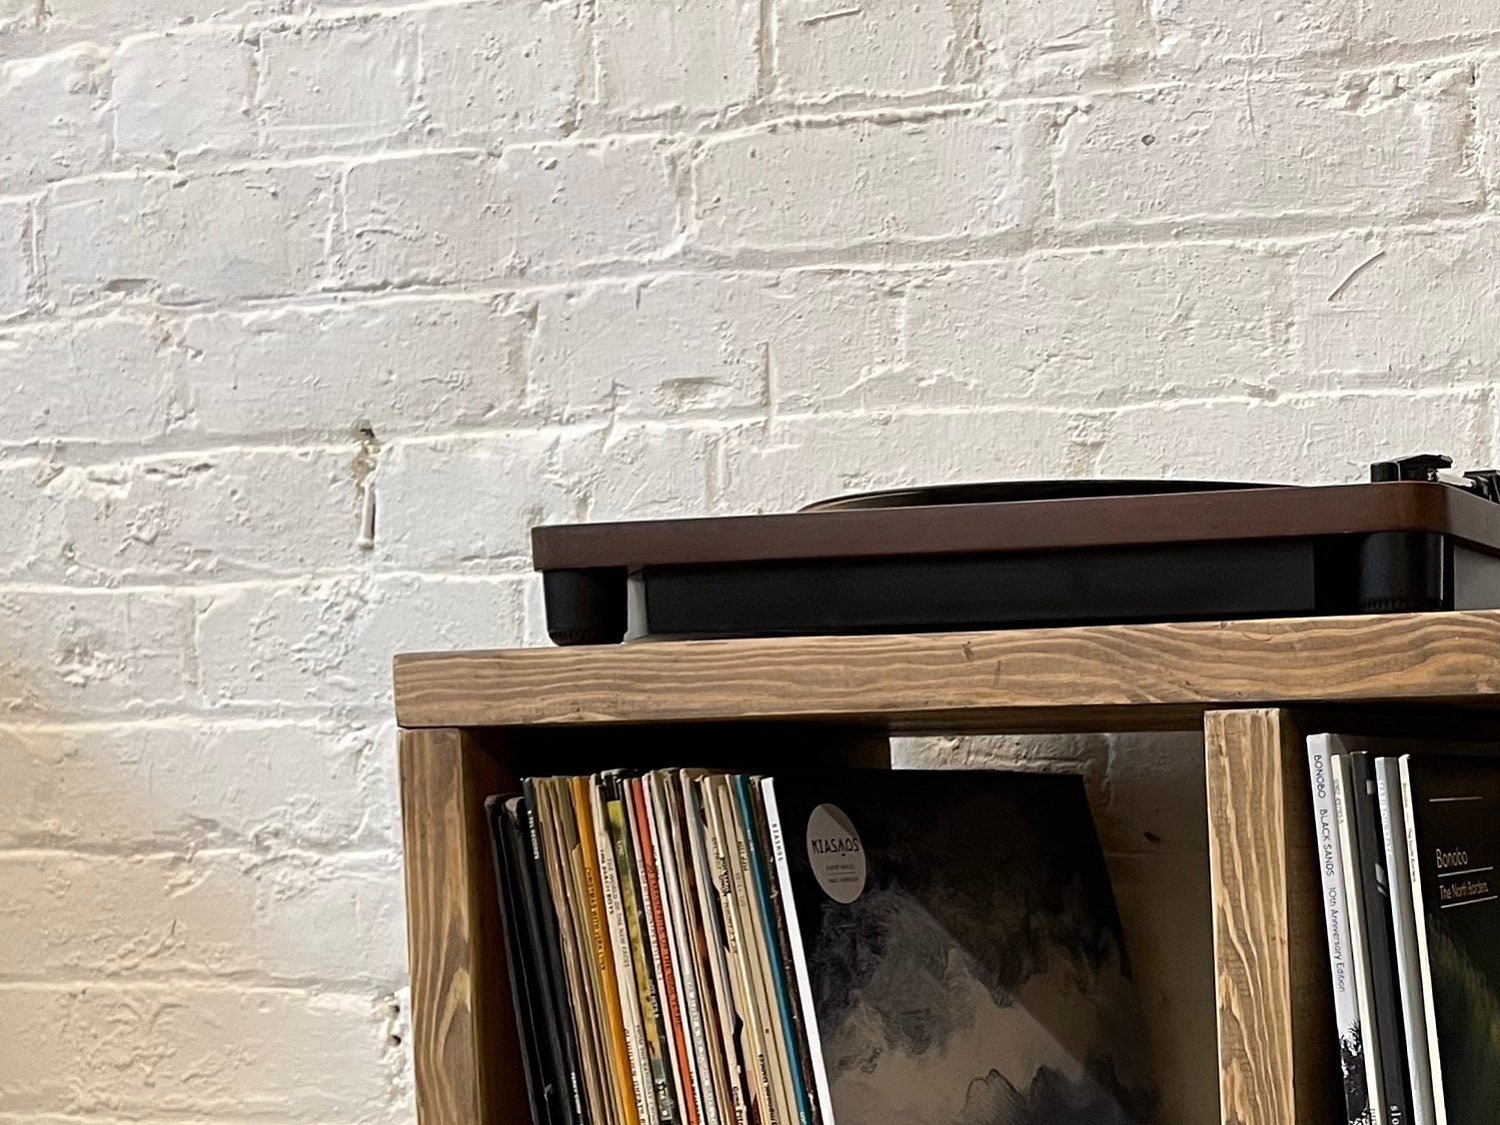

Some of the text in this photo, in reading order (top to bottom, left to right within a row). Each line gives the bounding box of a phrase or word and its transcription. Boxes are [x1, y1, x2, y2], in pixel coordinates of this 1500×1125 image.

[770, 822, 784, 861] KIASMOS
[1436, 847, 1469, 869] Bonobo
[601, 865, 610, 891] BEACH
[1313, 754, 1347, 993] BONOBO BLACK SANDS 10th Anniversary Edition
[608, 873, 618, 897] WORLD
[1439, 884, 1452, 900] The
[605, 893, 614, 915] BOYS
[617, 928, 626, 944] NEW
[620, 946, 630, 967] FACES
[732, 1085, 741, 1106] Gene
